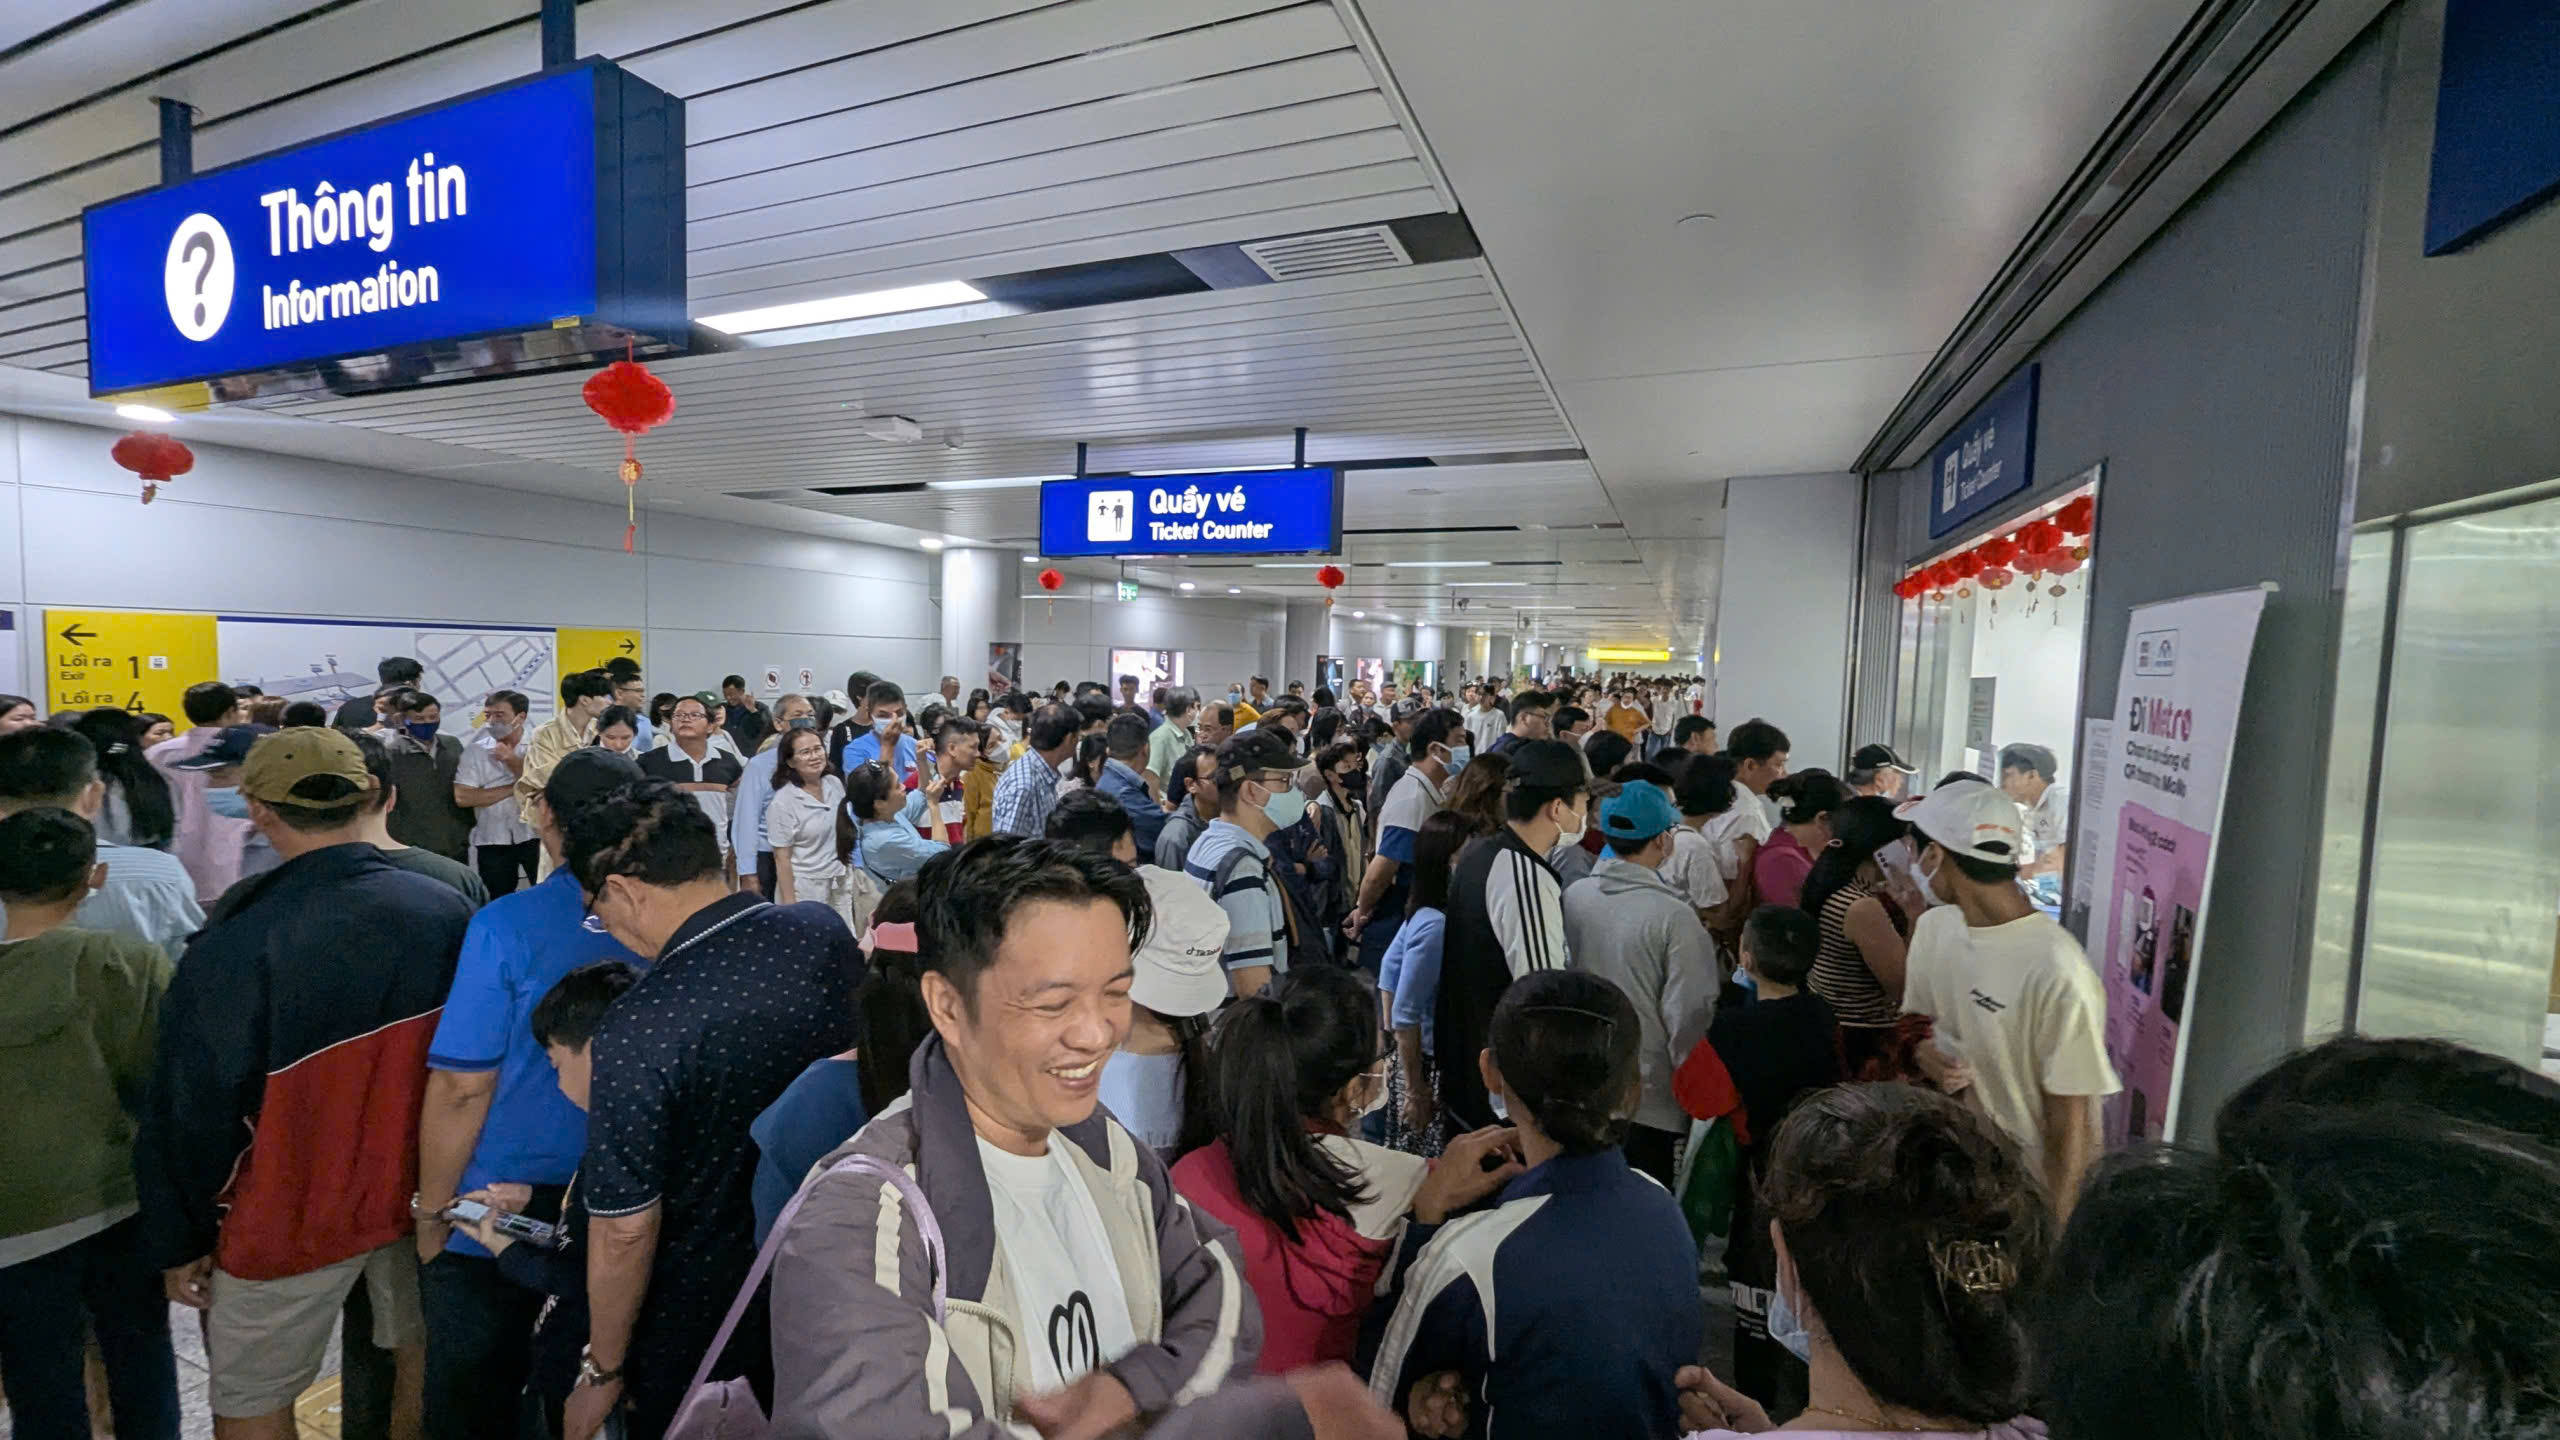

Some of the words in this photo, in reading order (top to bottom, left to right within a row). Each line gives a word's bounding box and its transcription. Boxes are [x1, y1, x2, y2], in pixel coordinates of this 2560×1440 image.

[261, 180, 393, 256] Thông
[406, 152, 467, 226] tin
[262, 259, 439, 330] Information
[1149, 485, 1211, 519] Quầy
[1216, 485, 1247, 512] vé
[1149, 522, 1200, 541] Ticket
[1202, 520, 1274, 540] Counter
[93, 656, 112, 667] ra
[128, 656, 140, 679] 1
[94, 694, 113, 704] ra
[126, 691, 145, 713] 4
